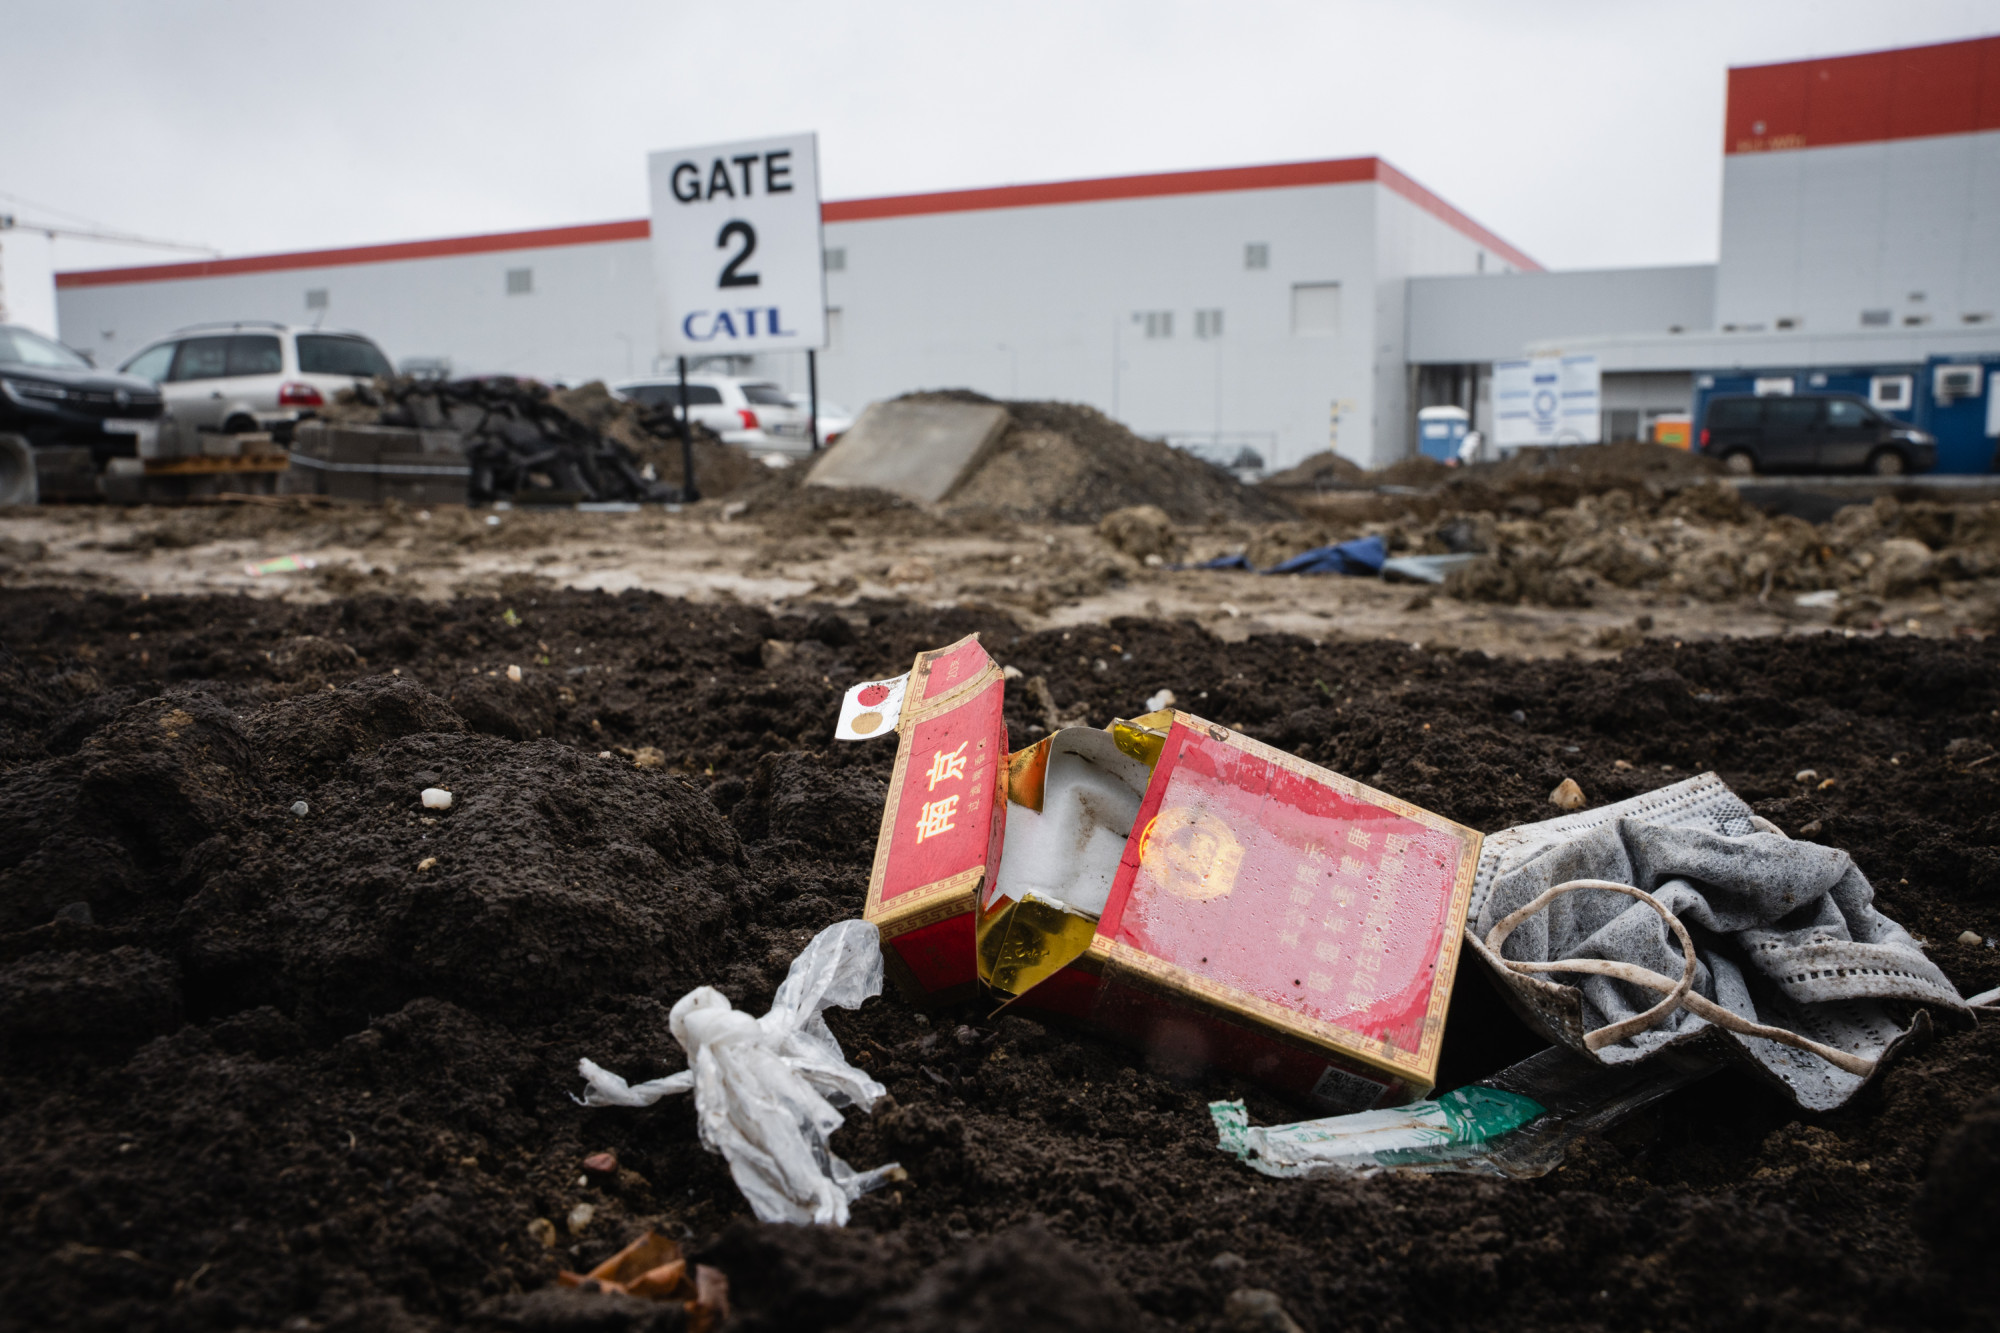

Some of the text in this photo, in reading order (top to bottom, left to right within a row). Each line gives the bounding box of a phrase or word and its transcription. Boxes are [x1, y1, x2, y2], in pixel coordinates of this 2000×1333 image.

[671, 151, 793, 203] GATE
[717, 219, 760, 288] 2
[683, 307, 796, 341] CATL
[916, 741, 968, 844] 南京
[1279, 842, 1326, 949] 本公司提示
[1307, 827, 1371, 993] 吸烟有害健康
